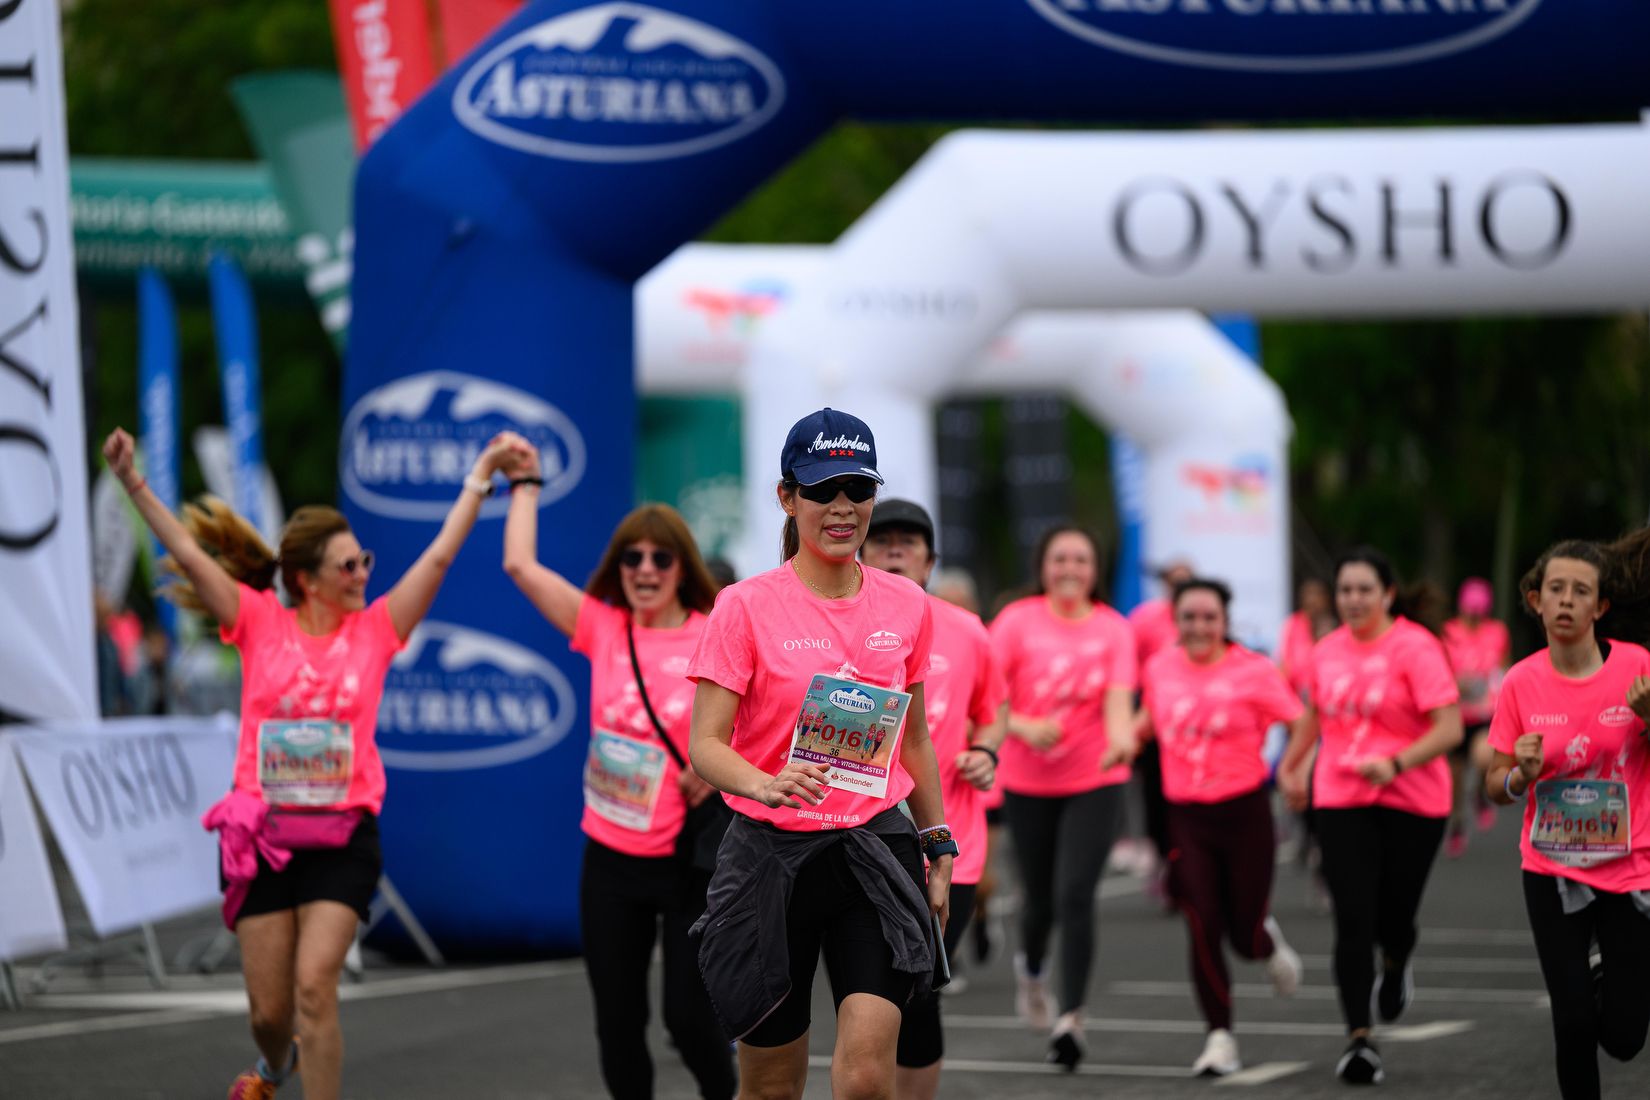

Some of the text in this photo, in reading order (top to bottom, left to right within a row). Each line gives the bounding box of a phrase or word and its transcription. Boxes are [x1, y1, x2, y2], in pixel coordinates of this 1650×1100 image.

[471, 57, 754, 123] ASTURIANA
[1111, 168, 1572, 277] OYSHO
[808, 432, 870, 453] Amsterdam
[783, 638, 832, 650] OYSHO
[868, 639, 900, 648] ASTURIANA
[831, 692, 872, 710] ASTURIANA
[821, 724, 862, 747] 016
[805, 751, 812, 759] DE
[813, 753, 819, 761] LA
[820, 755, 838, 765] MUJER
[841, 760, 884, 775] VITORIA-GASTEIZ
[60, 734, 197, 839] OYSHO
[839, 774, 873, 788] Santander
[797, 810, 860, 823] CARRERA DE LA MUJER
[1564, 818, 1598, 833] 016
